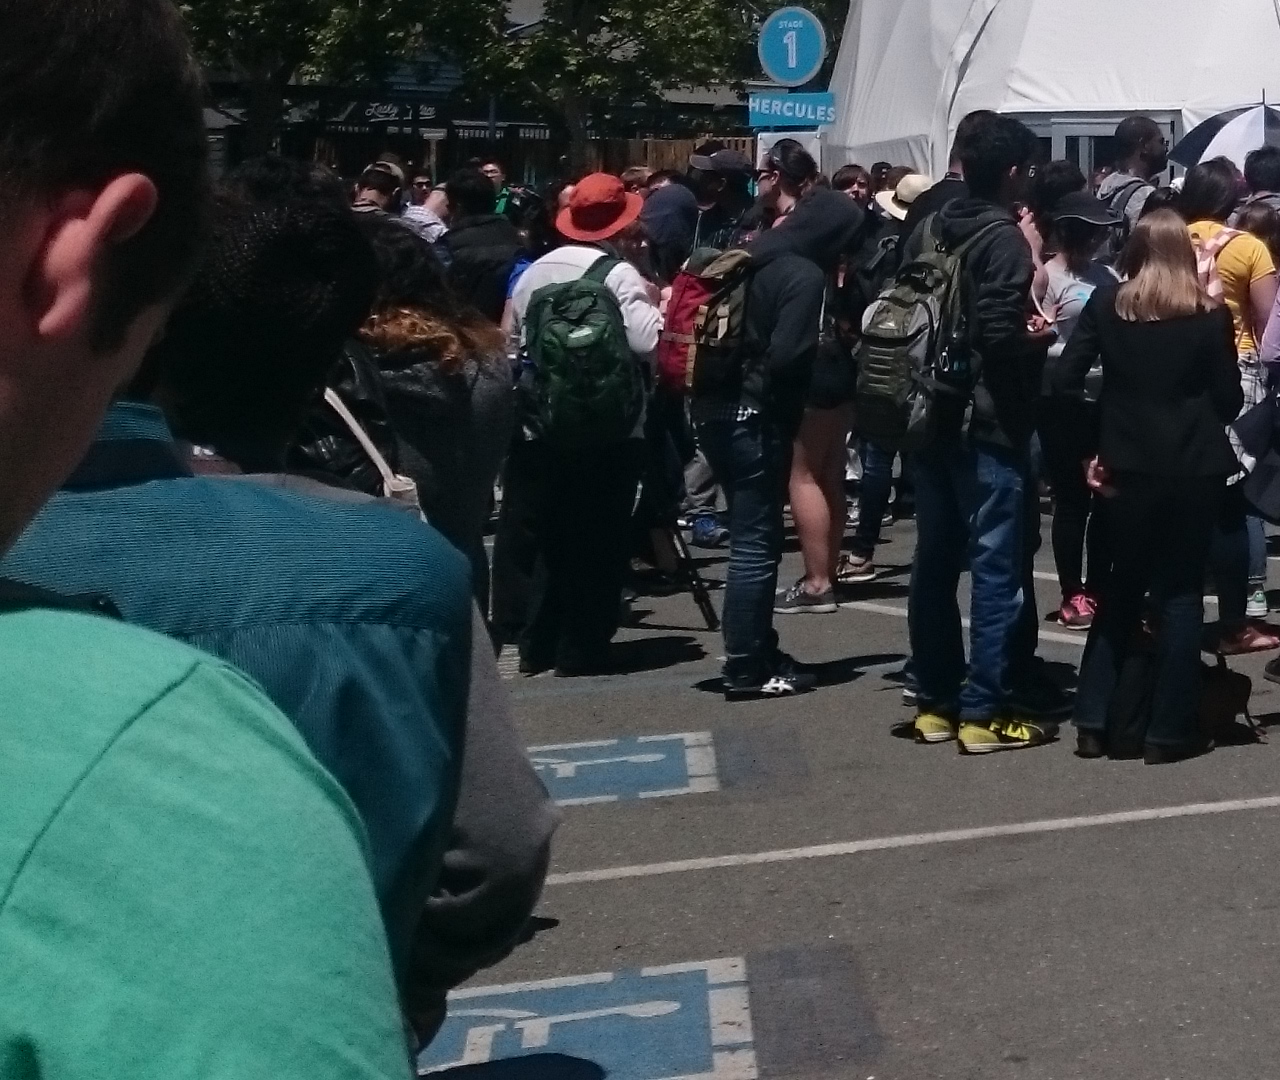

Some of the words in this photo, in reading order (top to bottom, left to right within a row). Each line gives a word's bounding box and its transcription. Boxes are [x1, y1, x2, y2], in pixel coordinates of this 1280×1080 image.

[778, 20, 804, 29] STAGE
[783, 30, 796, 69] 1
[748, 97, 836, 122] HERCULES
